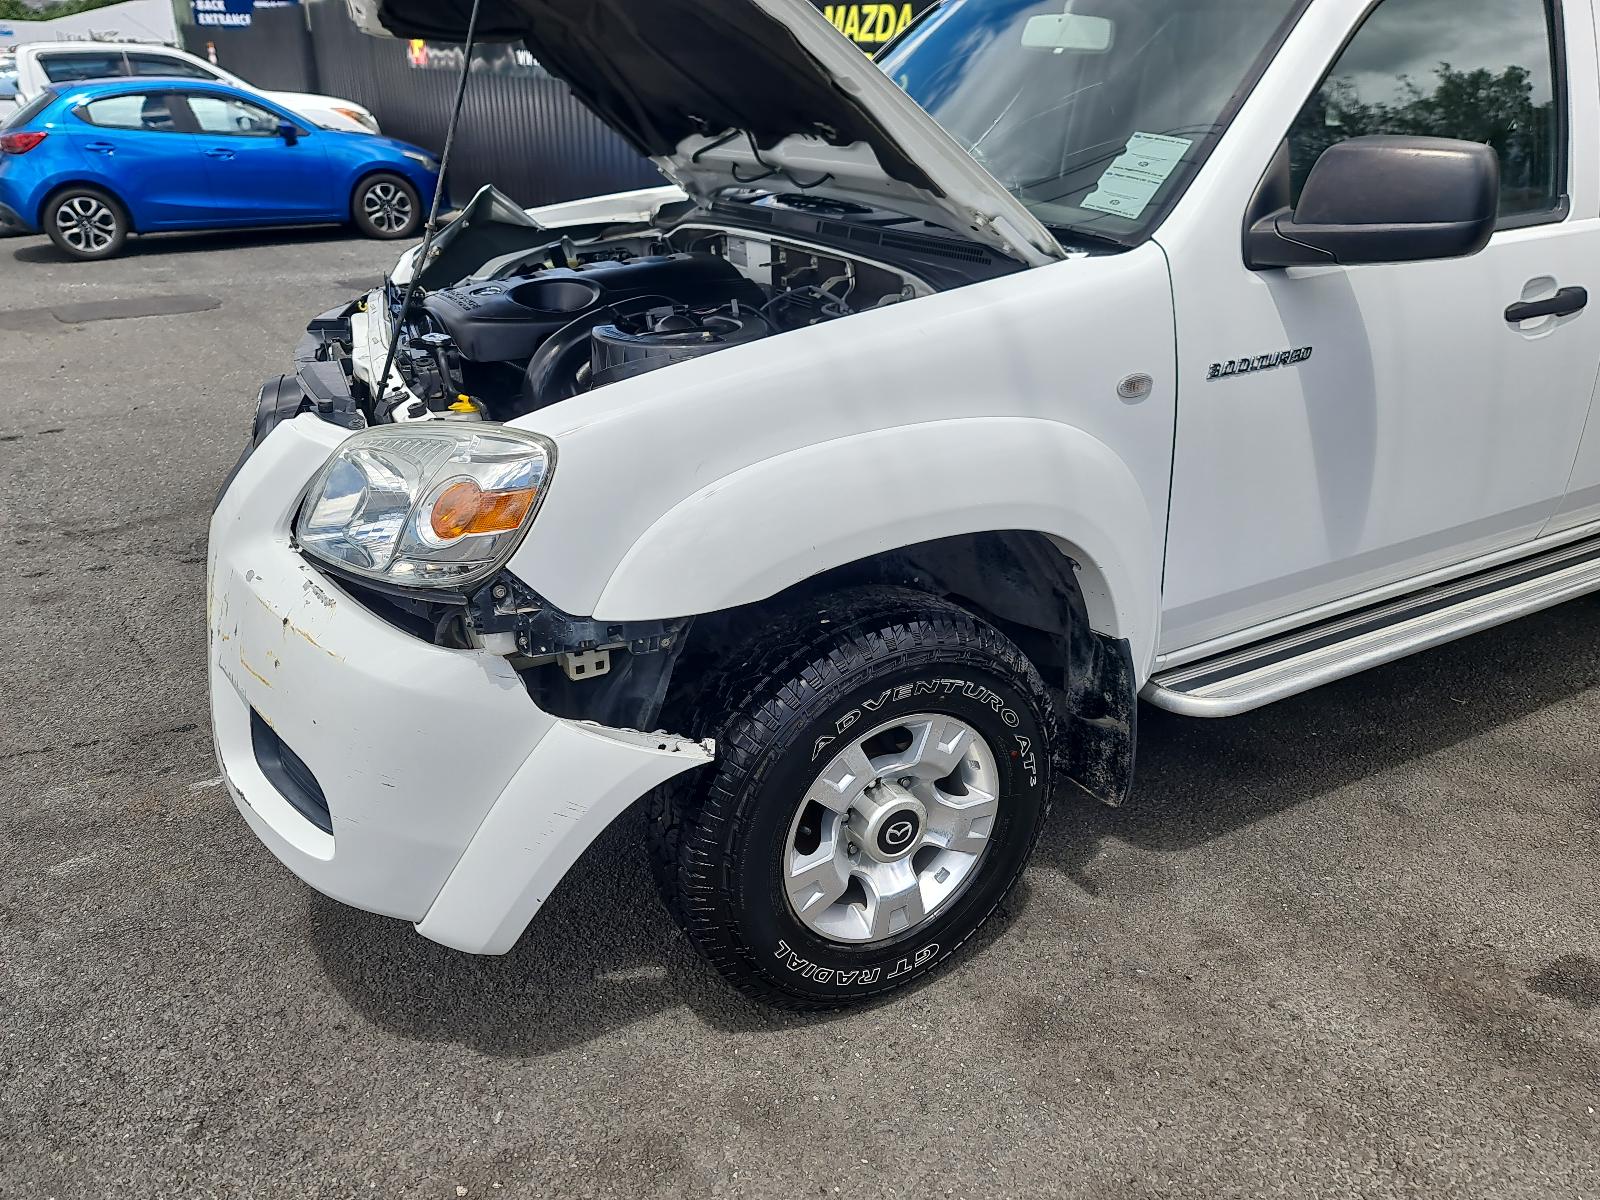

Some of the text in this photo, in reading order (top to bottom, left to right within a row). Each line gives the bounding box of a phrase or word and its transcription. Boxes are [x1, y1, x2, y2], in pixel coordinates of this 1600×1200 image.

[198, 13, 251, 26] ENTRANCE
[824, 3, 912, 42] MAZDA
[811, 678, 1020, 761] ADVENTURO
[773, 939, 939, 985] GT RADIAL
